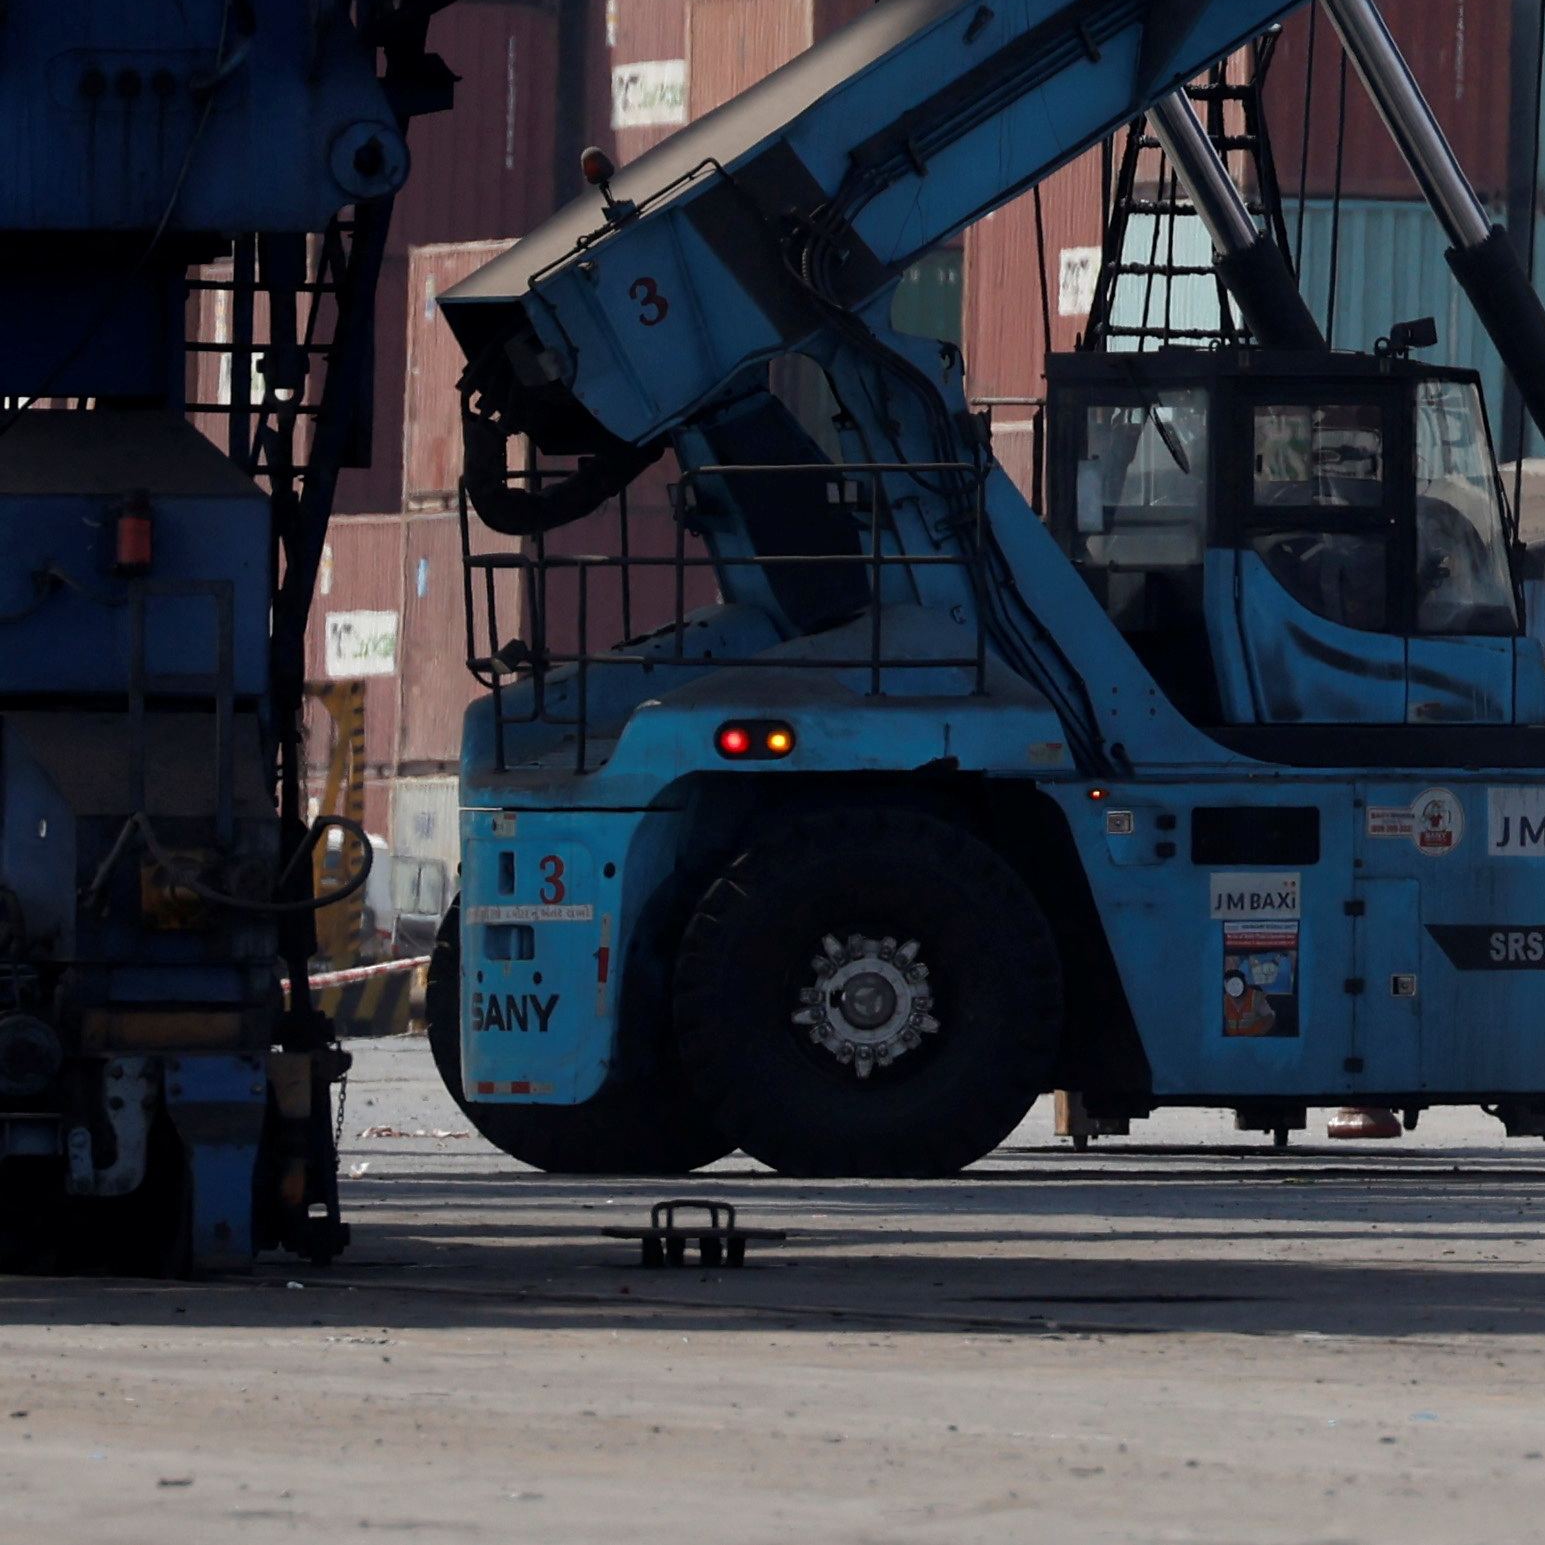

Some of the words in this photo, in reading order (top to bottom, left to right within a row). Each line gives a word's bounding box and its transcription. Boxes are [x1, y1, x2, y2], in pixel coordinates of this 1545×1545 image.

[627, 276, 669, 327] 3
[539, 854, 567, 905] 3
[472, 992, 561, 1033] SANY
